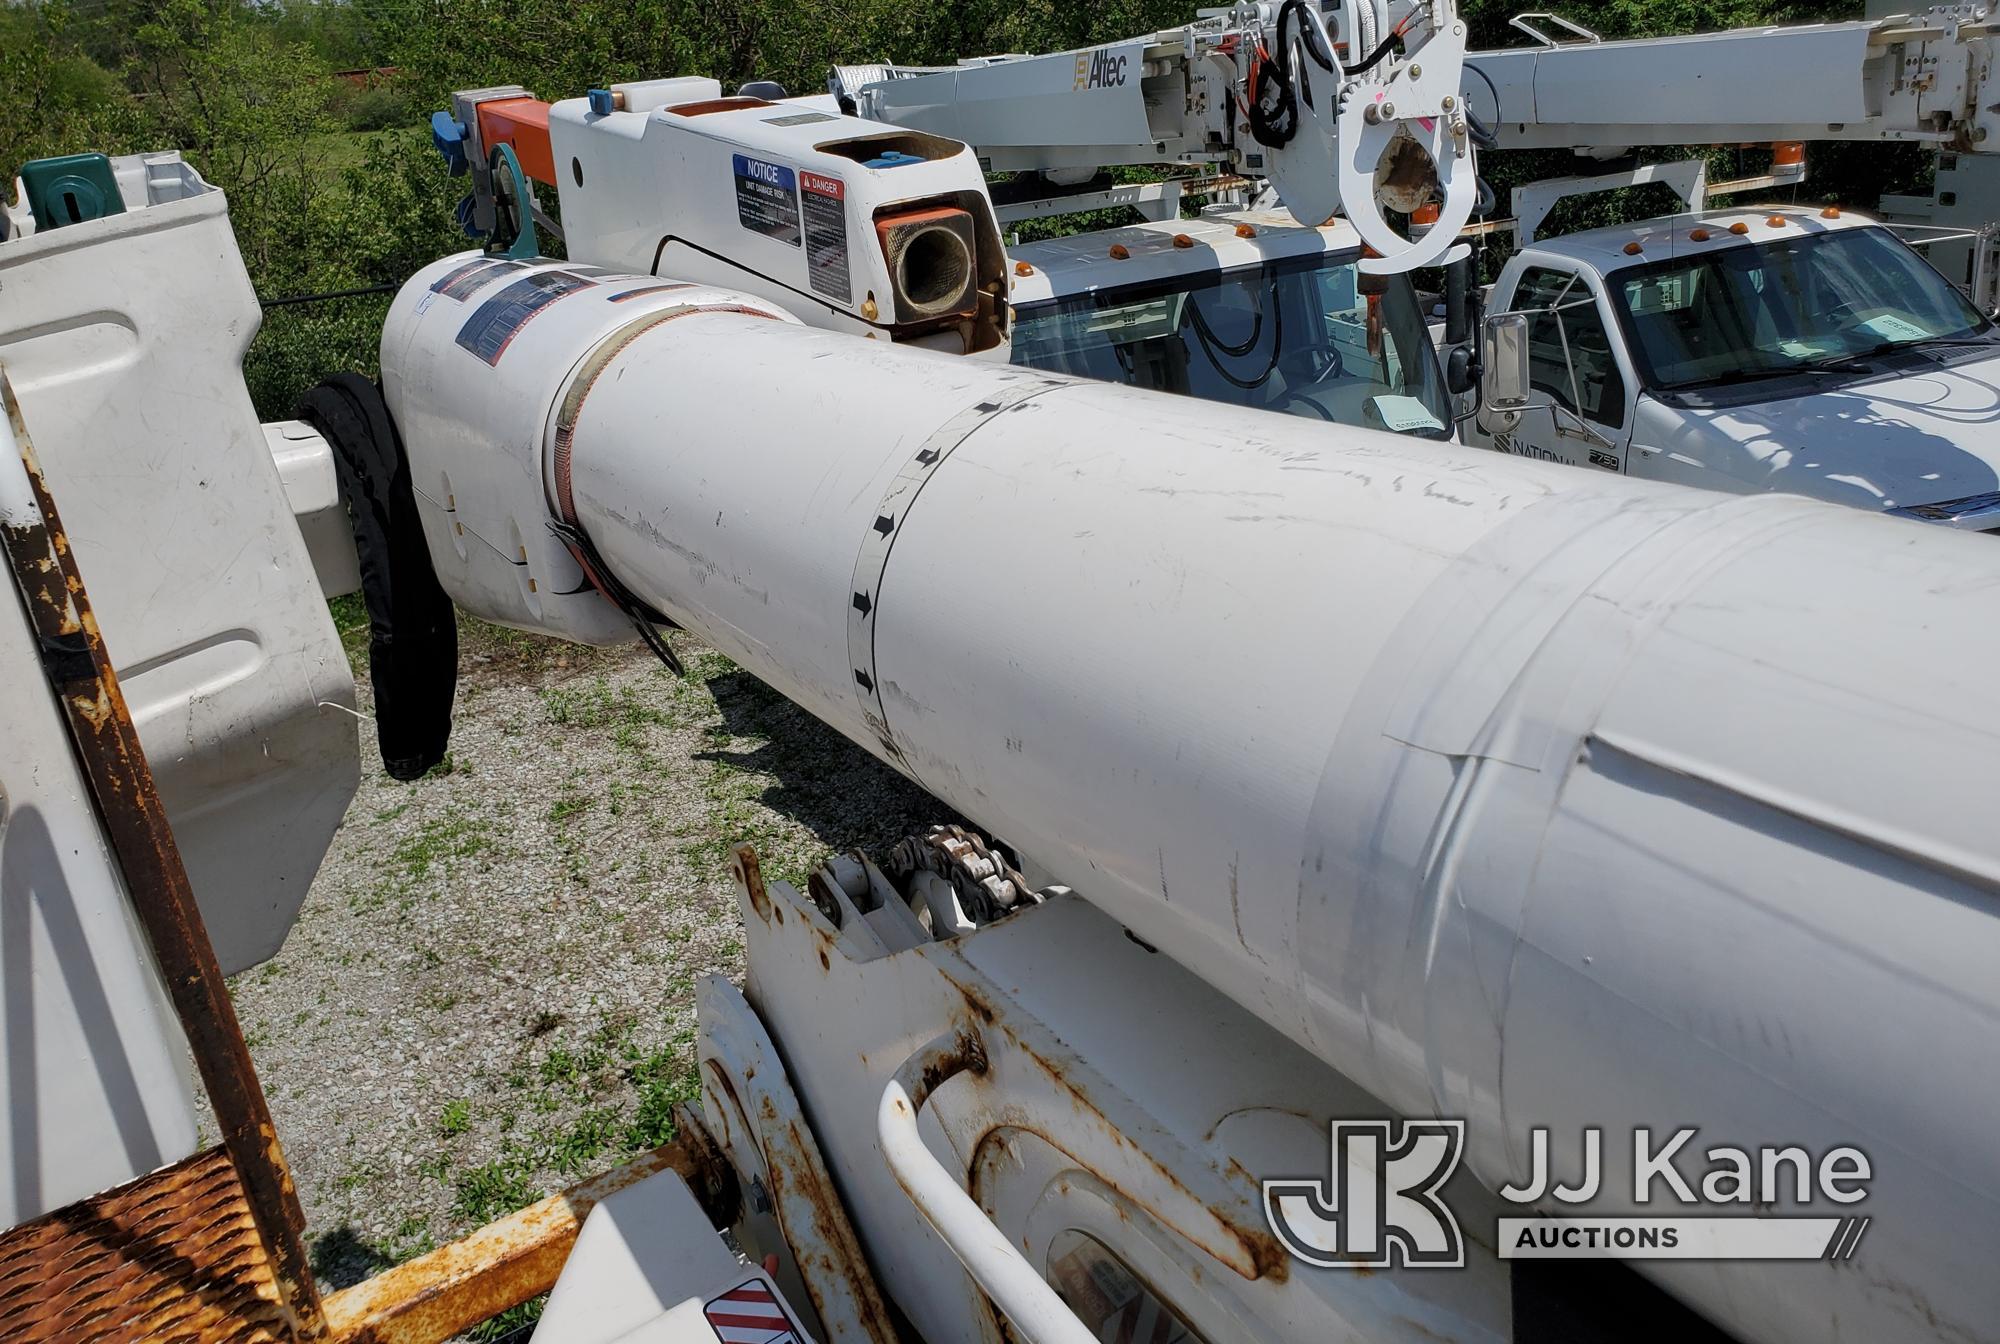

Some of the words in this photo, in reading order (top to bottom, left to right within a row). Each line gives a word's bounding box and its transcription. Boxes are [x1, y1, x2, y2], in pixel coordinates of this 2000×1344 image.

[1088, 49, 1127, 89] Altec
[747, 159, 779, 184] NOTICE
[756, 183, 774, 197] DAMAGE
[774, 189, 785, 200] RISK
[812, 178, 838, 195] DANGER
